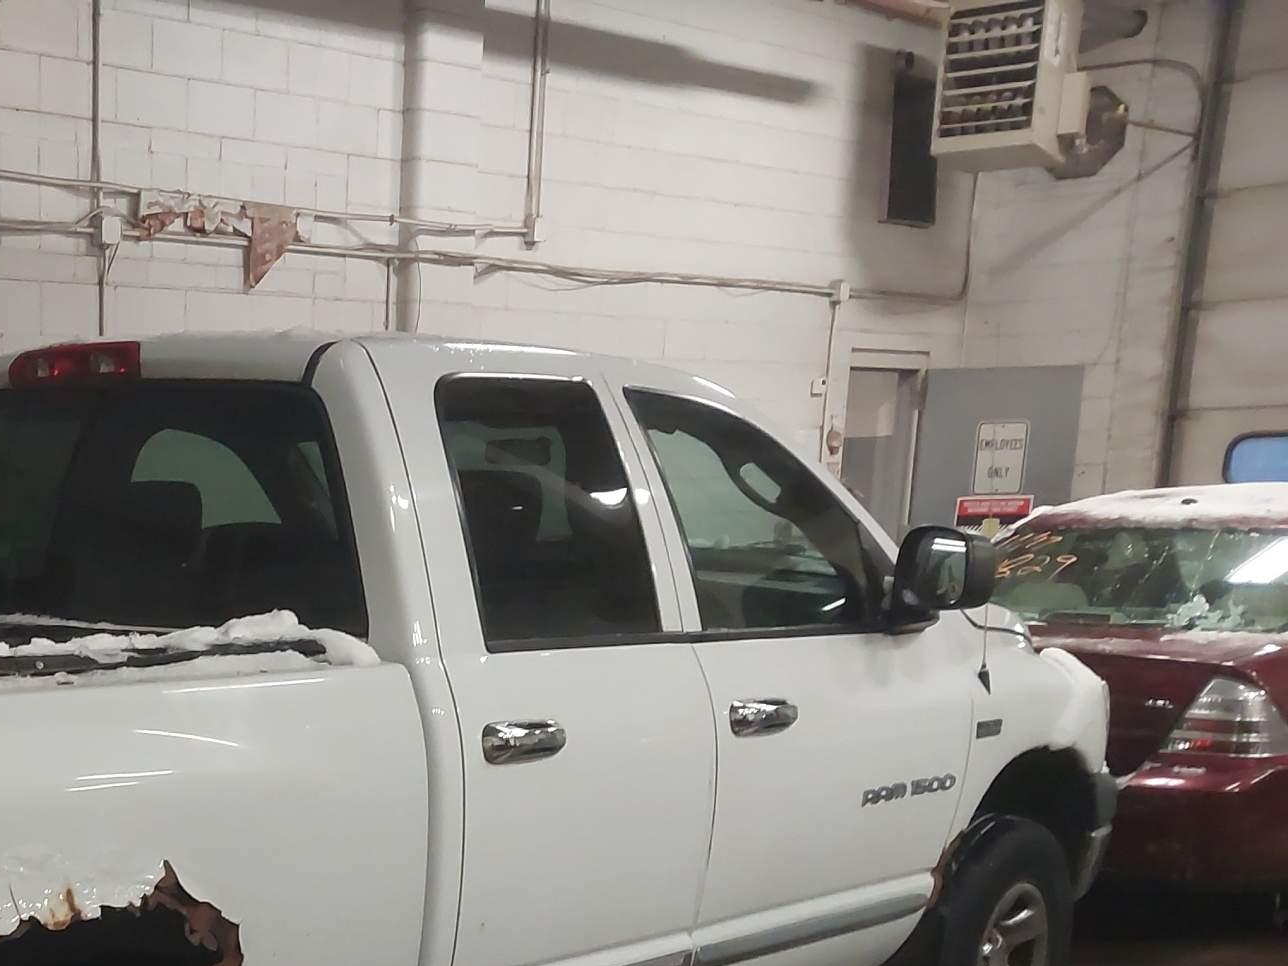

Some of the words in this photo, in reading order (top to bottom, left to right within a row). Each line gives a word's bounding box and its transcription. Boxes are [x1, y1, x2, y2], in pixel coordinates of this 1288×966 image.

[980, 438, 1024, 451] EMPLOYEES
[987, 465, 1010, 479] ONLY
[861, 782, 907, 808] RAM
[910, 773, 957, 796] 1500
